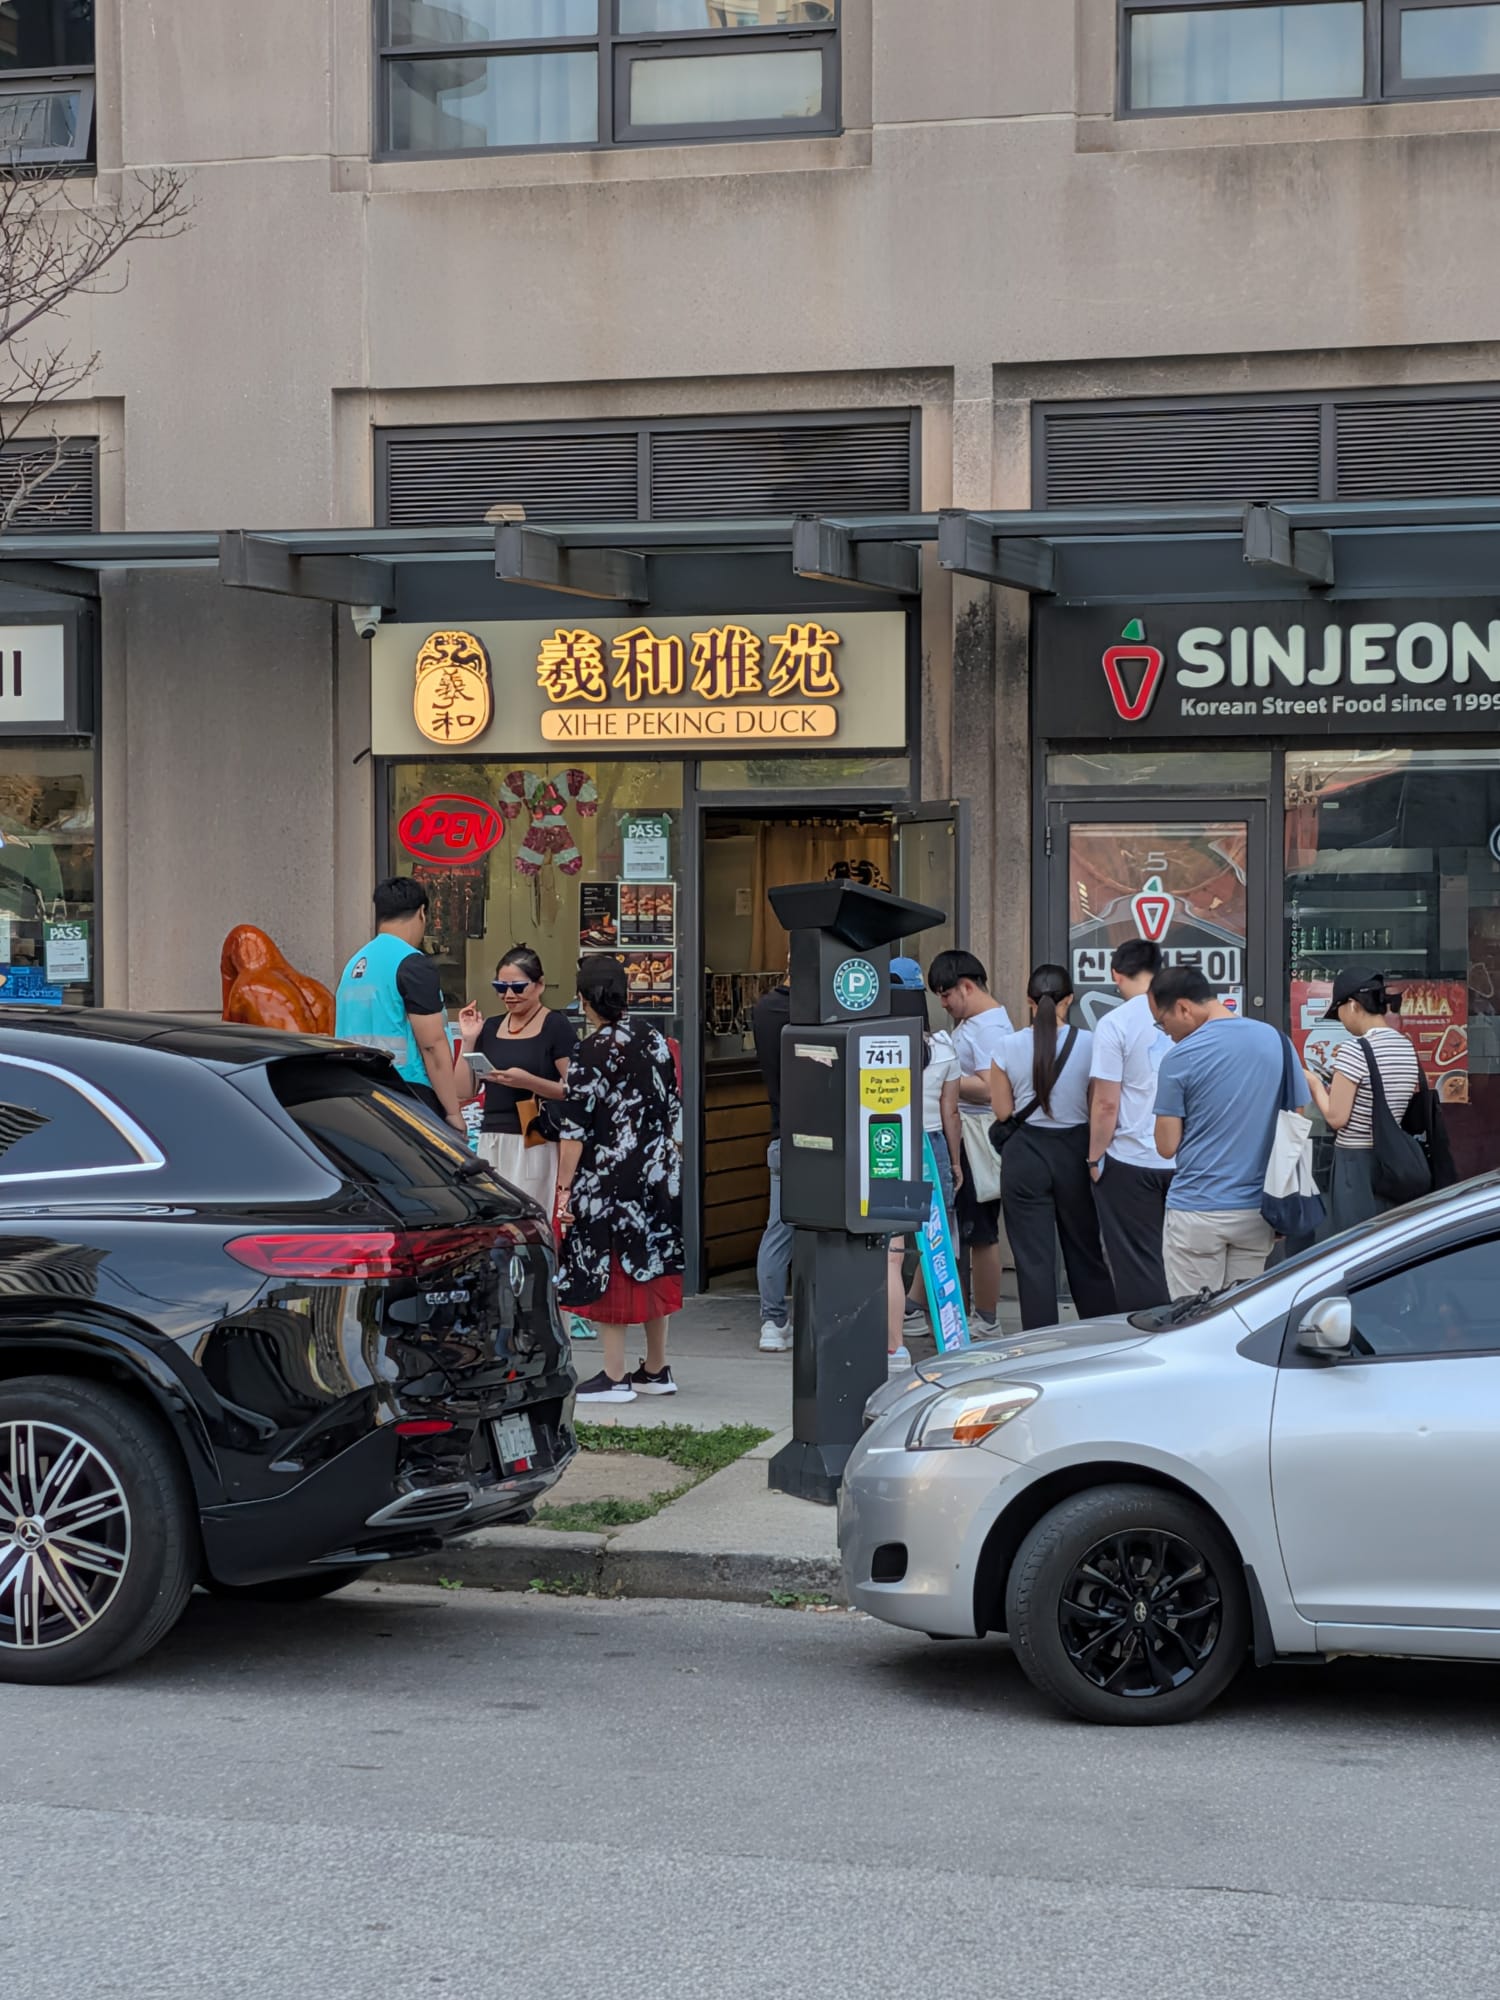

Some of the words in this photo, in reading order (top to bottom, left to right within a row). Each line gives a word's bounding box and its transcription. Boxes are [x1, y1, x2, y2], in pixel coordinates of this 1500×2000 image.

[1176, 621, 1500, 688] SINJEON
[1181, 699, 1257, 716] Korean
[1262, 697, 1327, 714] Street
[1332, 695, 1386, 713] Food
[1391, 695, 1446, 712] since
[557, 713, 617, 736] XIHE
[627, 712, 725, 735] PEKING
[736, 709, 818, 733] DUCK
[402, 811, 493, 848] OPEN
[628, 824, 663, 838] PASS
[50, 927, 82, 940] PASS
[849, 973, 865, 992] P
[1400, 998, 1453, 1016] MALA
[866, 1050, 902, 1064] 7411
[881, 1135, 891, 1146] P
